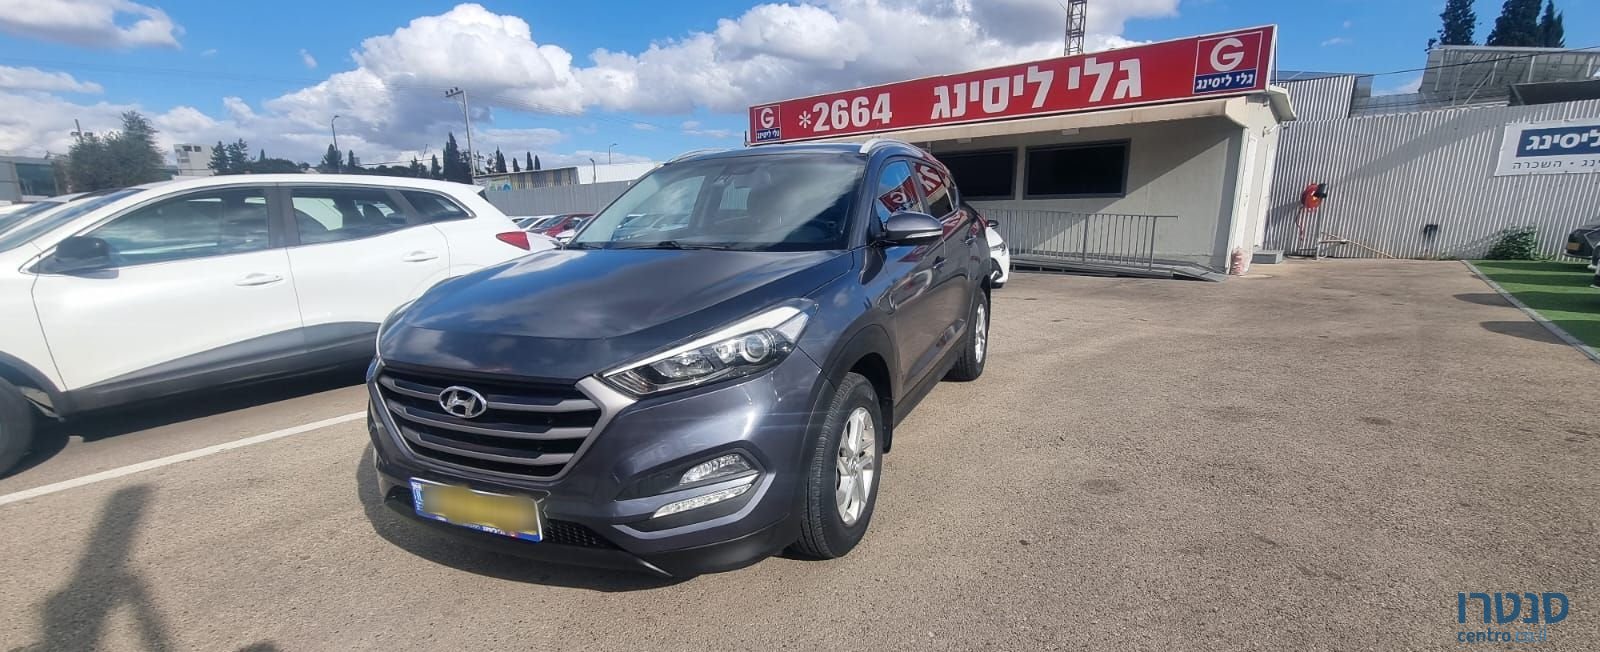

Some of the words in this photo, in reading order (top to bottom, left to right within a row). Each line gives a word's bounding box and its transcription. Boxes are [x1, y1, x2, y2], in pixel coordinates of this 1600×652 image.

[1210, 37, 1244, 71] G
[1068, 57, 1142, 103] גלי
[1195, 74, 1232, 90] ליסינג
[1235, 72, 1254, 85] גלי
[930, 65, 1054, 120] ליסינג
[760, 107, 774, 128] G
[1512, 160, 1562, 169] השכרה
